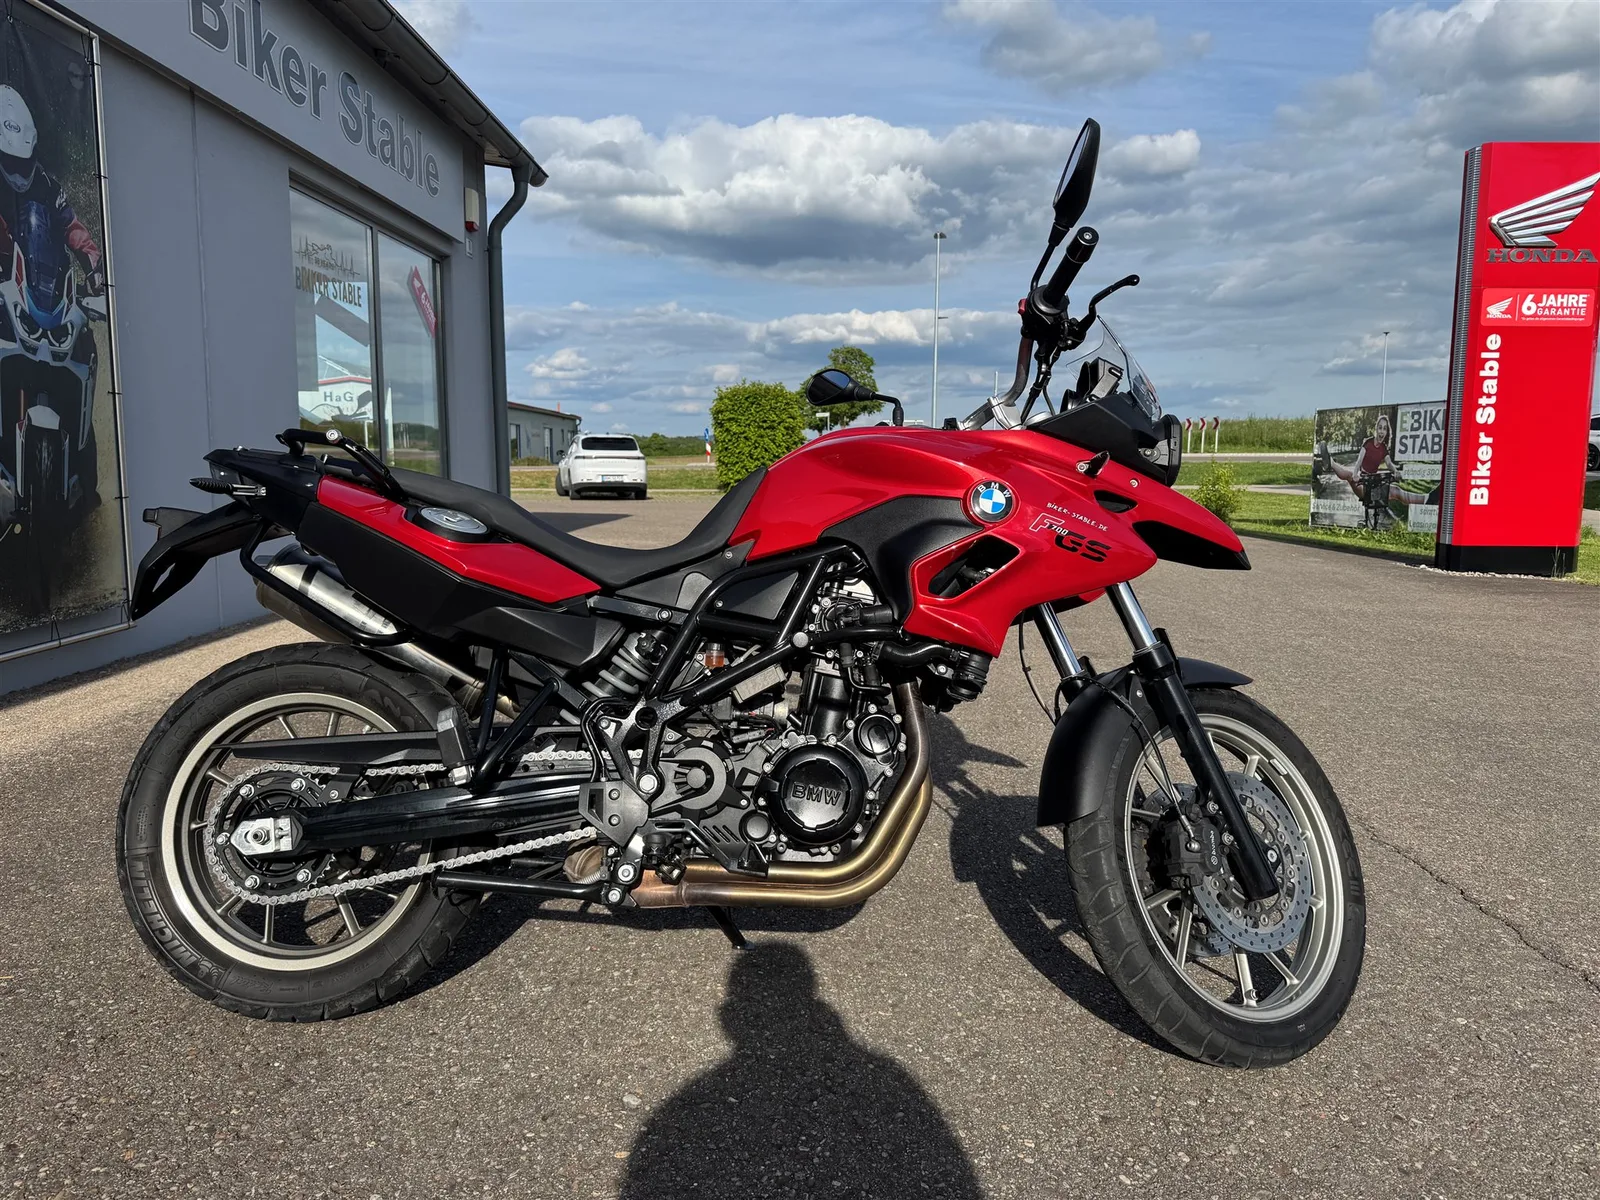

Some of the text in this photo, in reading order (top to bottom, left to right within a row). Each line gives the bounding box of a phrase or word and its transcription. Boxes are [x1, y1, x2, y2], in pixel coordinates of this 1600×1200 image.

[338, 70, 441, 198] Stable
[1486, 248, 1599, 264] HONDA
[331, 277, 362, 308] STABLE
[1521, 293, 1537, 315] 6
[1537, 308, 1586, 316] GARANTIE
[1469, 333, 1502, 506] Biker Stable
[978, 481, 1012, 498] BMW
[1051, 524, 1069, 536] 700
[1055, 530, 1112, 563] GS
[792, 781, 841, 806] BMW
[129, 857, 198, 968] MICHELIN
